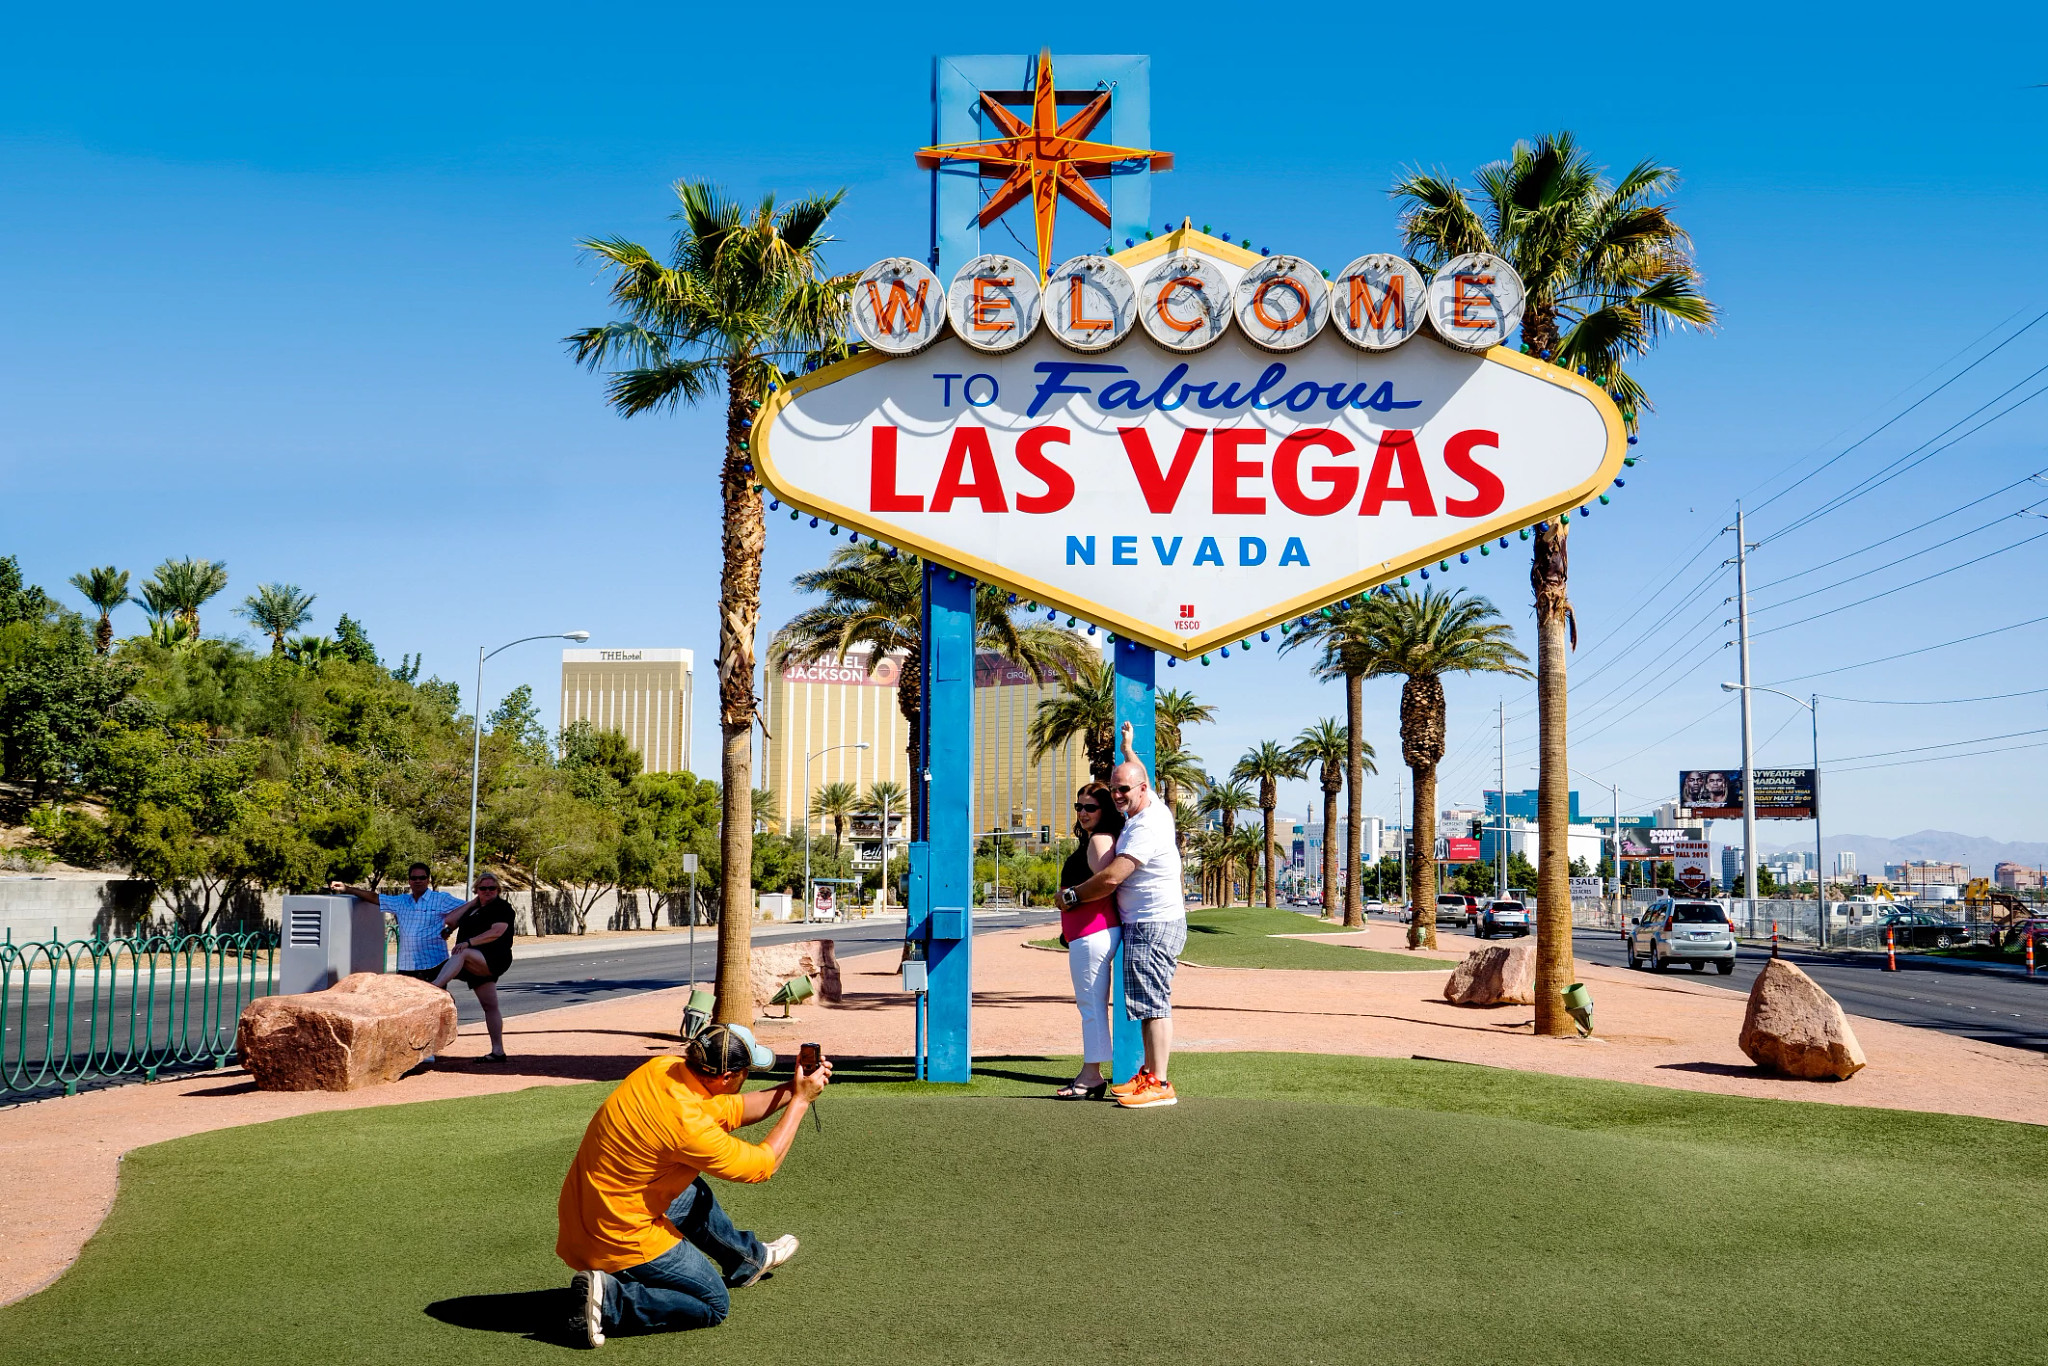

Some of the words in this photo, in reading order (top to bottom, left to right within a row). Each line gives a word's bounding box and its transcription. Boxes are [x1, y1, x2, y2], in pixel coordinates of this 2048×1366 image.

[866, 275, 1496, 335] WELCOME
[933, 374, 1000, 408] TO
[1026, 361, 1423, 419] Fabulous
[869, 426, 1075, 514] LAS
[1117, 426, 1505, 518] VEGAS
[1066, 535, 1311, 567] NEVADA
[1174, 620, 1201, 630] YESCO
[786, 667, 864, 682] JACKSON
[1753, 770, 1805, 778] AYWEATHER
[1753, 777, 1796, 785] MAIDANA
[1650, 830, 1686, 838] DONNY
